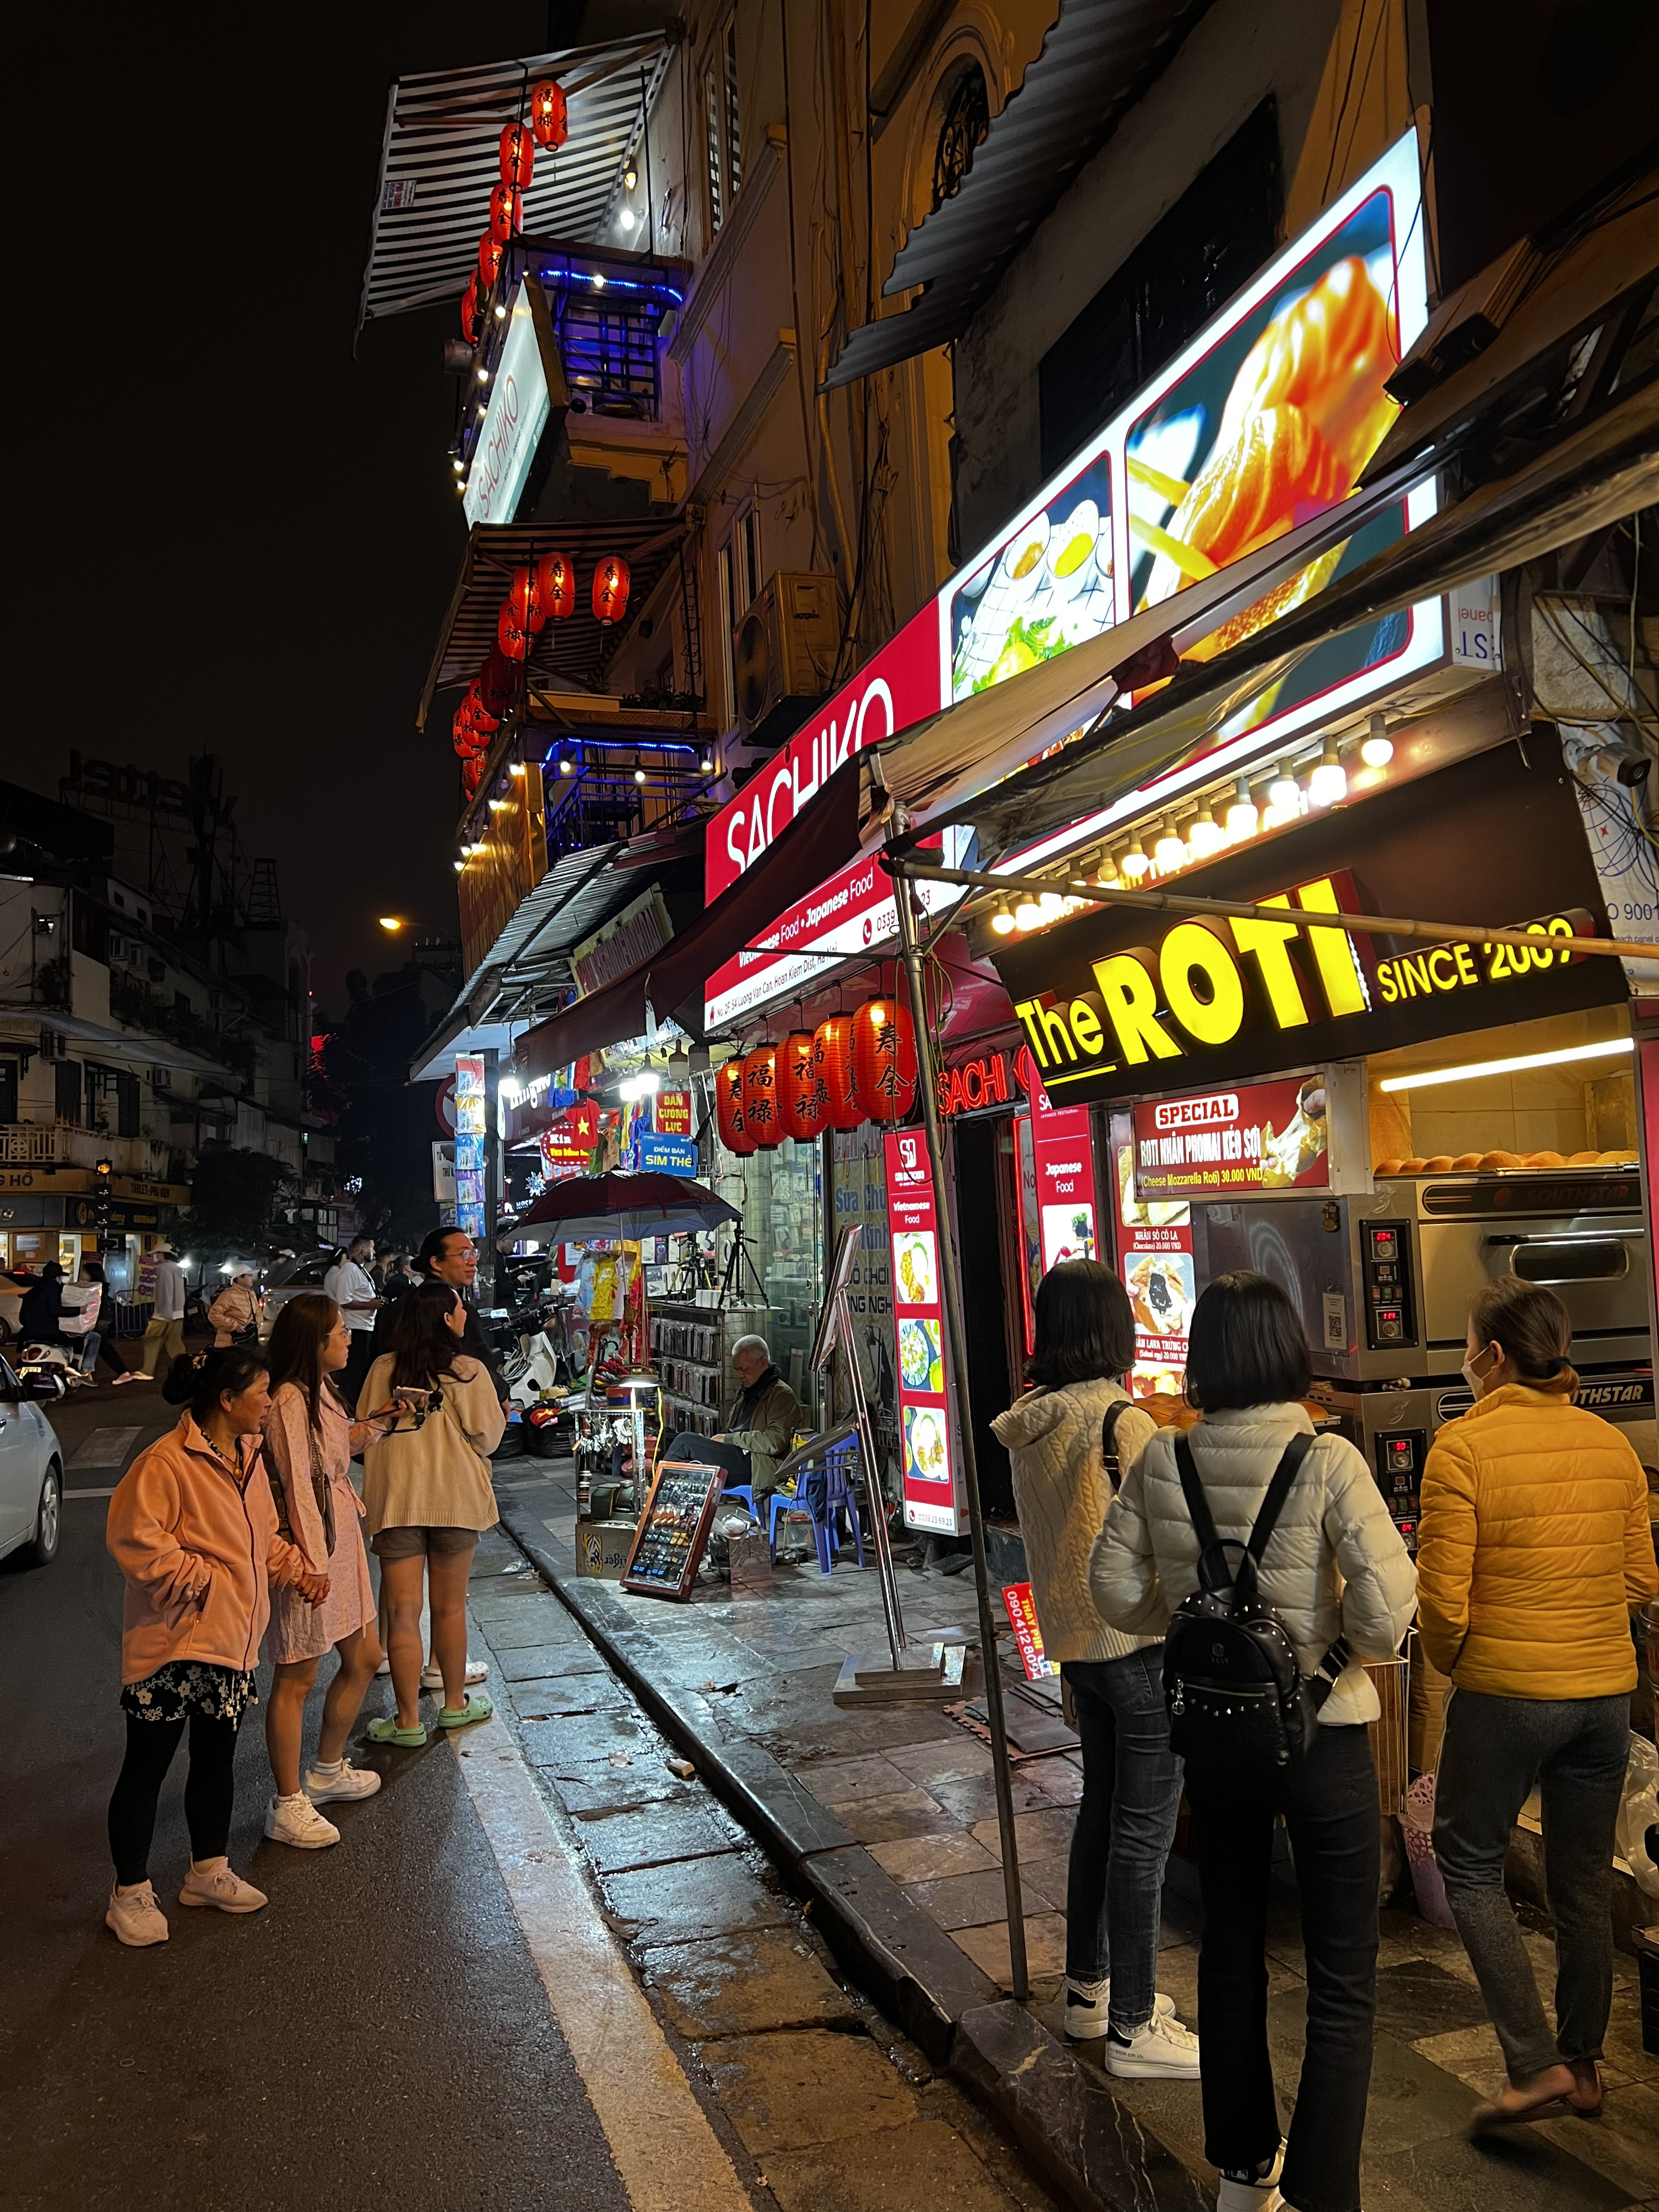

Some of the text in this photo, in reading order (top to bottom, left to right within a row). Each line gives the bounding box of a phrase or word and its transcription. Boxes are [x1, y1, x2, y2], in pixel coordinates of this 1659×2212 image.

[478, 374, 518, 519] SACHIKO
[549, 560, 568, 601] 寿全
[599, 564, 617, 603] 寿全
[780, 915, 800, 944] Food
[805, 888, 849, 928] Japanese
[850, 867, 873, 901] Food
[1015, 878, 1366, 1070] The ROTI
[1376, 917, 1574, 1003] SINCE 2009
[774, 972, 787, 988] Hoan
[875, 1020, 910, 1097] 寿全
[747, 1064, 774, 1125] 福禄
[937, 1044, 1029, 1116] SACHIK
[664, 1093, 683, 1106] DÁN
[1159, 1099, 1234, 1125] SPECIAL
[645, 1155, 667, 1166] SIM
[1140, 1139, 1159, 1167] ROTI
[1160, 1131, 1185, 1165] NHÂN
[1185, 1132, 1222, 1163] PHOMAI
[1222, 1124, 1241, 1161] KÉO
[1046, 1162, 1082, 1178] Japanese
[1056, 1179, 1074, 1193] Food
[1141, 1167, 1263, 1190] (Cheese Mozzarella Roti) 30.000 VND
[836, 1184, 859, 1213] Sửa
[893, 1201, 930, 1212] Vietnamese
[905, 1214, 920, 1224] Food
[1570, 1385, 1644, 1406] UTHSTAR
[1021, 1598, 1036, 1626] THAY
[1030, 1628, 1043, 1650] PIN
